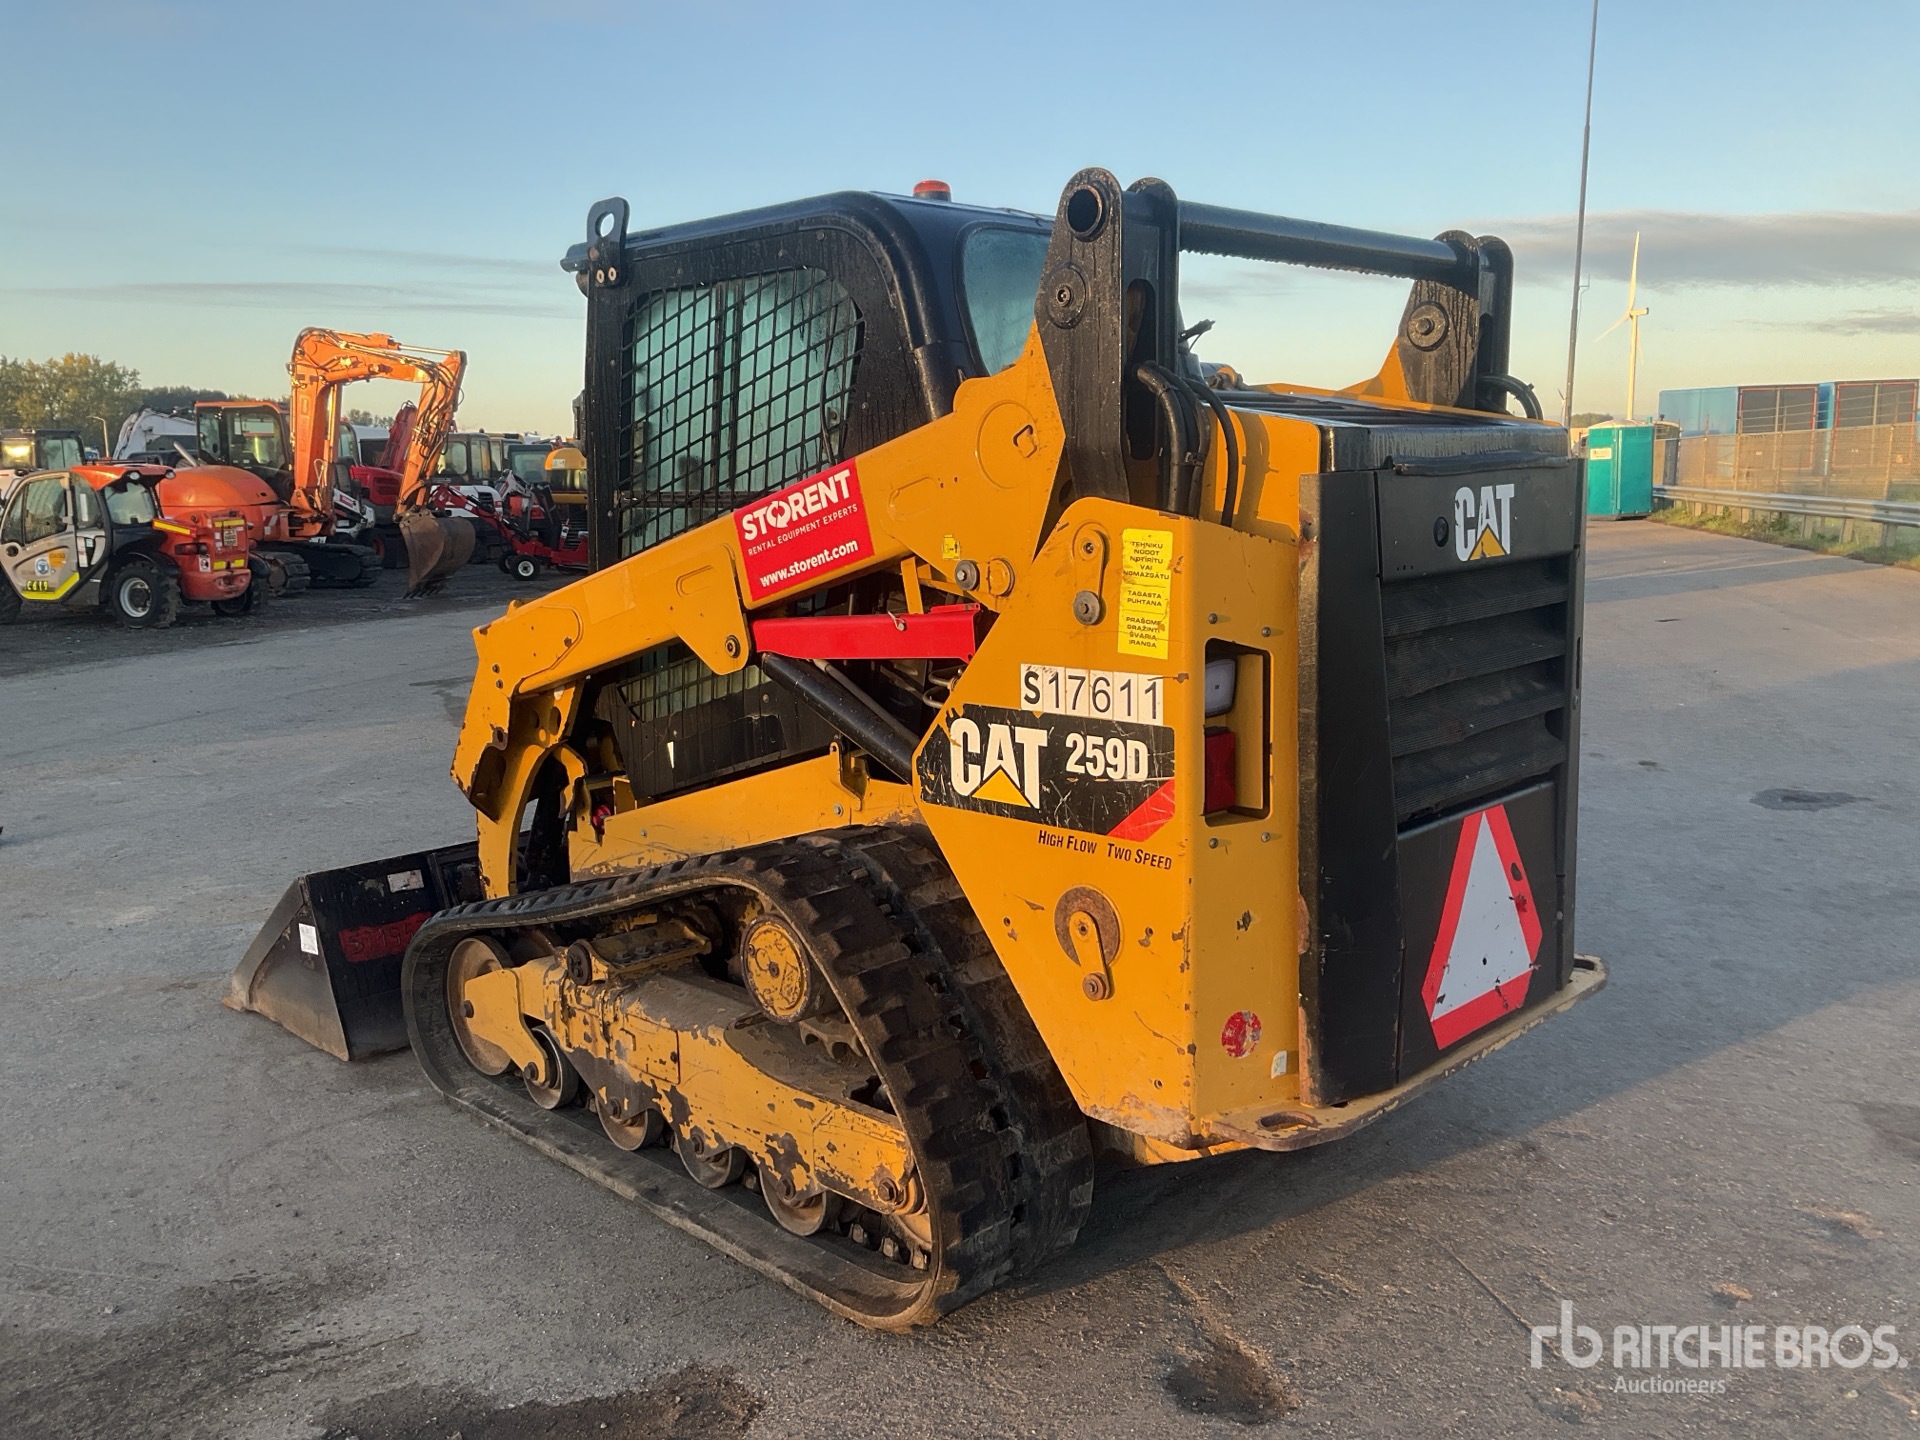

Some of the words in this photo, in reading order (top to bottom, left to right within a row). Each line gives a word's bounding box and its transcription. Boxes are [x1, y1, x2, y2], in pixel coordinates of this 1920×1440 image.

[742, 469, 850, 541] STORENT
[748, 539, 776, 556] RENTAL
[777, 519, 821, 544] EQUIPMENT
[823, 503, 858, 525] EXPERTS
[1454, 483, 1515, 562] CAT
[759, 539, 859, 588] www.storent.com
[1131, 541, 1163, 549] TEHNIKU
[1127, 590, 1162, 599] TAGASTA
[1127, 597, 1162, 606] PUHTANA
[1023, 670, 1159, 720] S17611
[950, 717, 1048, 810] CAT
[1065, 732, 1149, 783] 259D
[1038, 829, 1063, 849] HIGH
[1066, 834, 1098, 855] FLOW
[1107, 843, 1132, 862] TWO
[1134, 849, 1173, 871] SPEED
